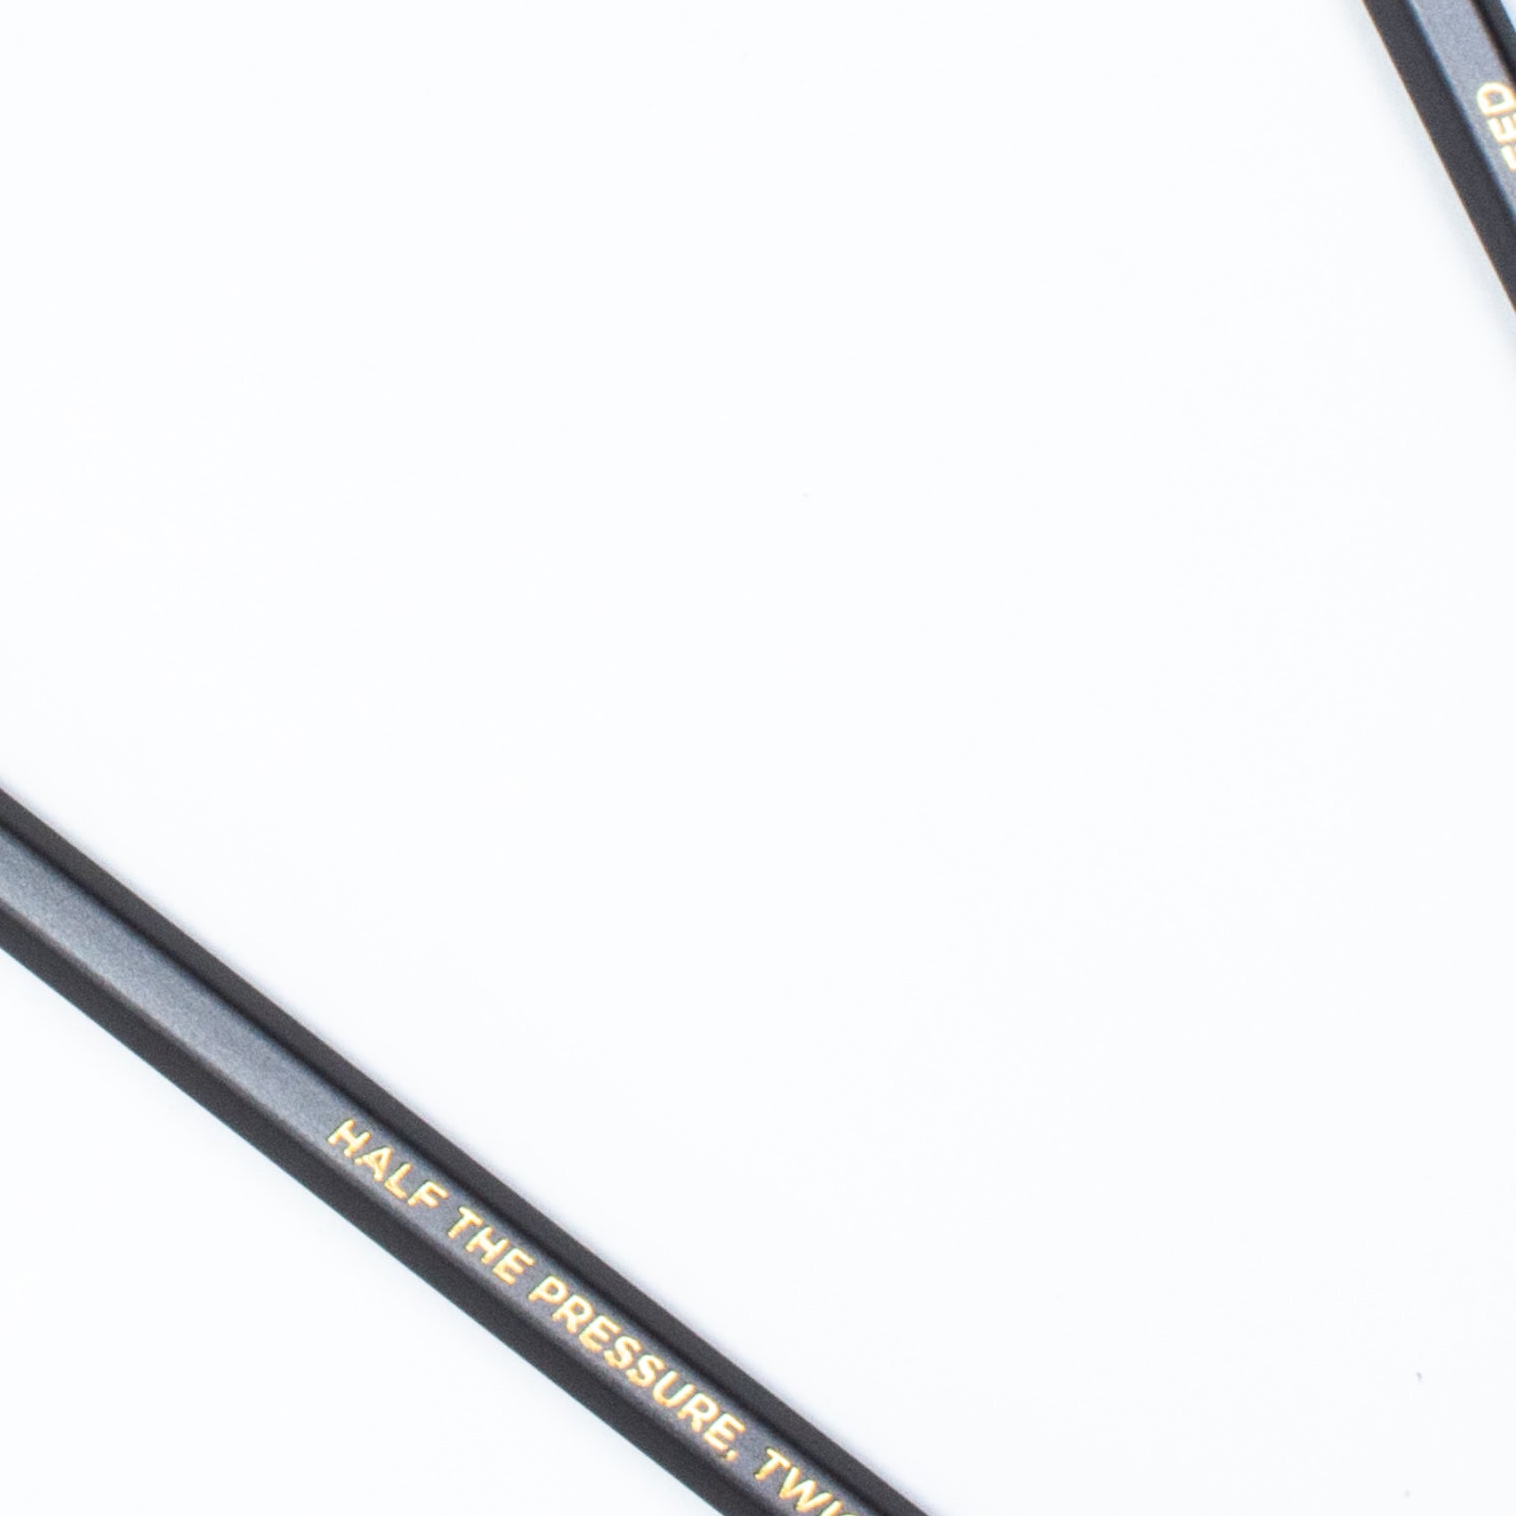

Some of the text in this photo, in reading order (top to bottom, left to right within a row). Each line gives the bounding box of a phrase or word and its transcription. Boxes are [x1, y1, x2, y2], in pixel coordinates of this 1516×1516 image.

[327, 1118, 857, 1516] HALF THE PRESSURE, TWI
